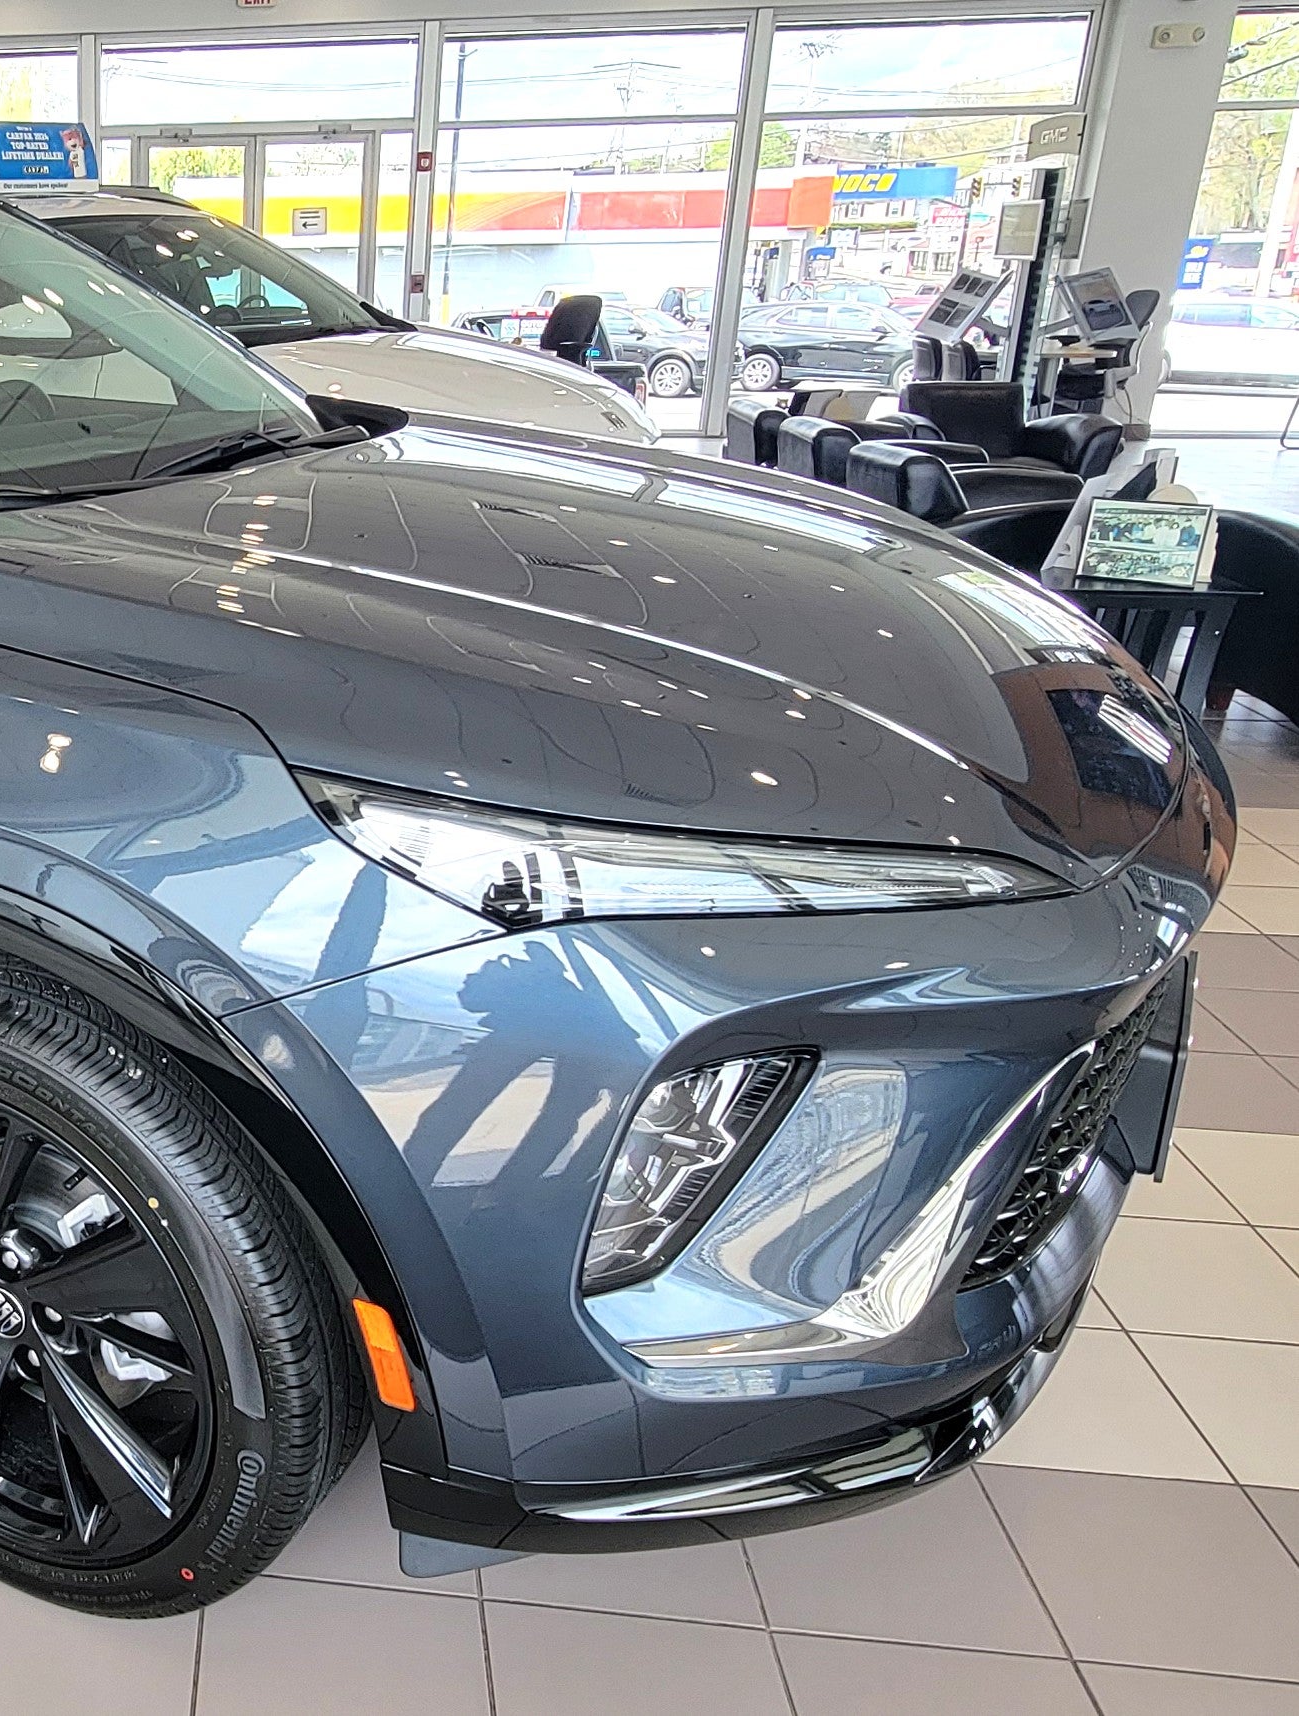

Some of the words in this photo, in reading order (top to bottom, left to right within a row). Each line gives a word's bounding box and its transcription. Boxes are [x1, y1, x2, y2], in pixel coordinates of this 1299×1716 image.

[1040, 126, 1069, 145] GMC
[10, 141, 49, 150] TOP-RATED
[2, 151, 36, 160] LIFETIME
[205, 1449, 266, 1564] Continental
